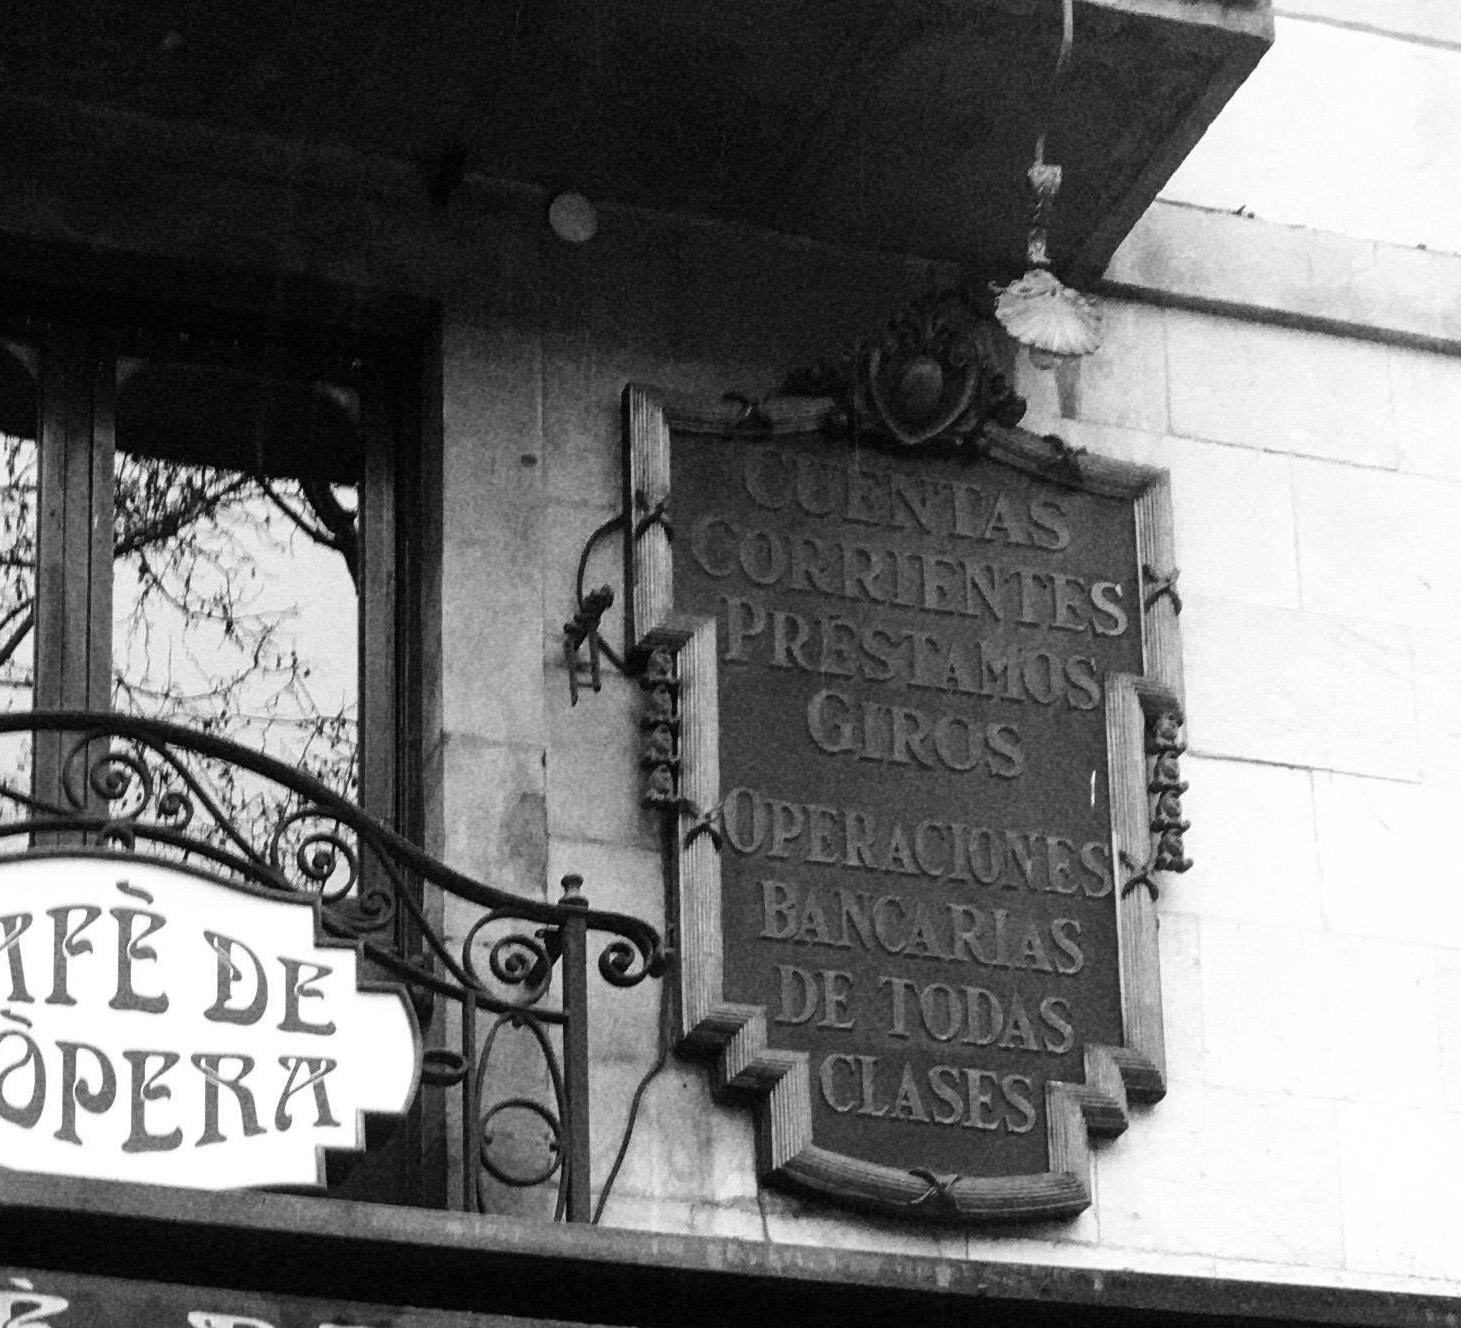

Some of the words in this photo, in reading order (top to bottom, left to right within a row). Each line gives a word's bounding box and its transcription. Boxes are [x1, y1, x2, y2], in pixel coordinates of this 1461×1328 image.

[744, 449, 1071, 552] CUENTAS
[690, 516, 1129, 637] CORRIENTES
[807, 688, 1025, 778] GIROS
[723, 787, 1115, 899] OPERACIONES
[759, 880, 1085, 975] BANCARIAS
[202, 928, 338, 1036] DE
[776, 963, 854, 1031] DE
[879, 974, 1076, 1055] TODAS
[819, 1054, 1037, 1134] CLASES
